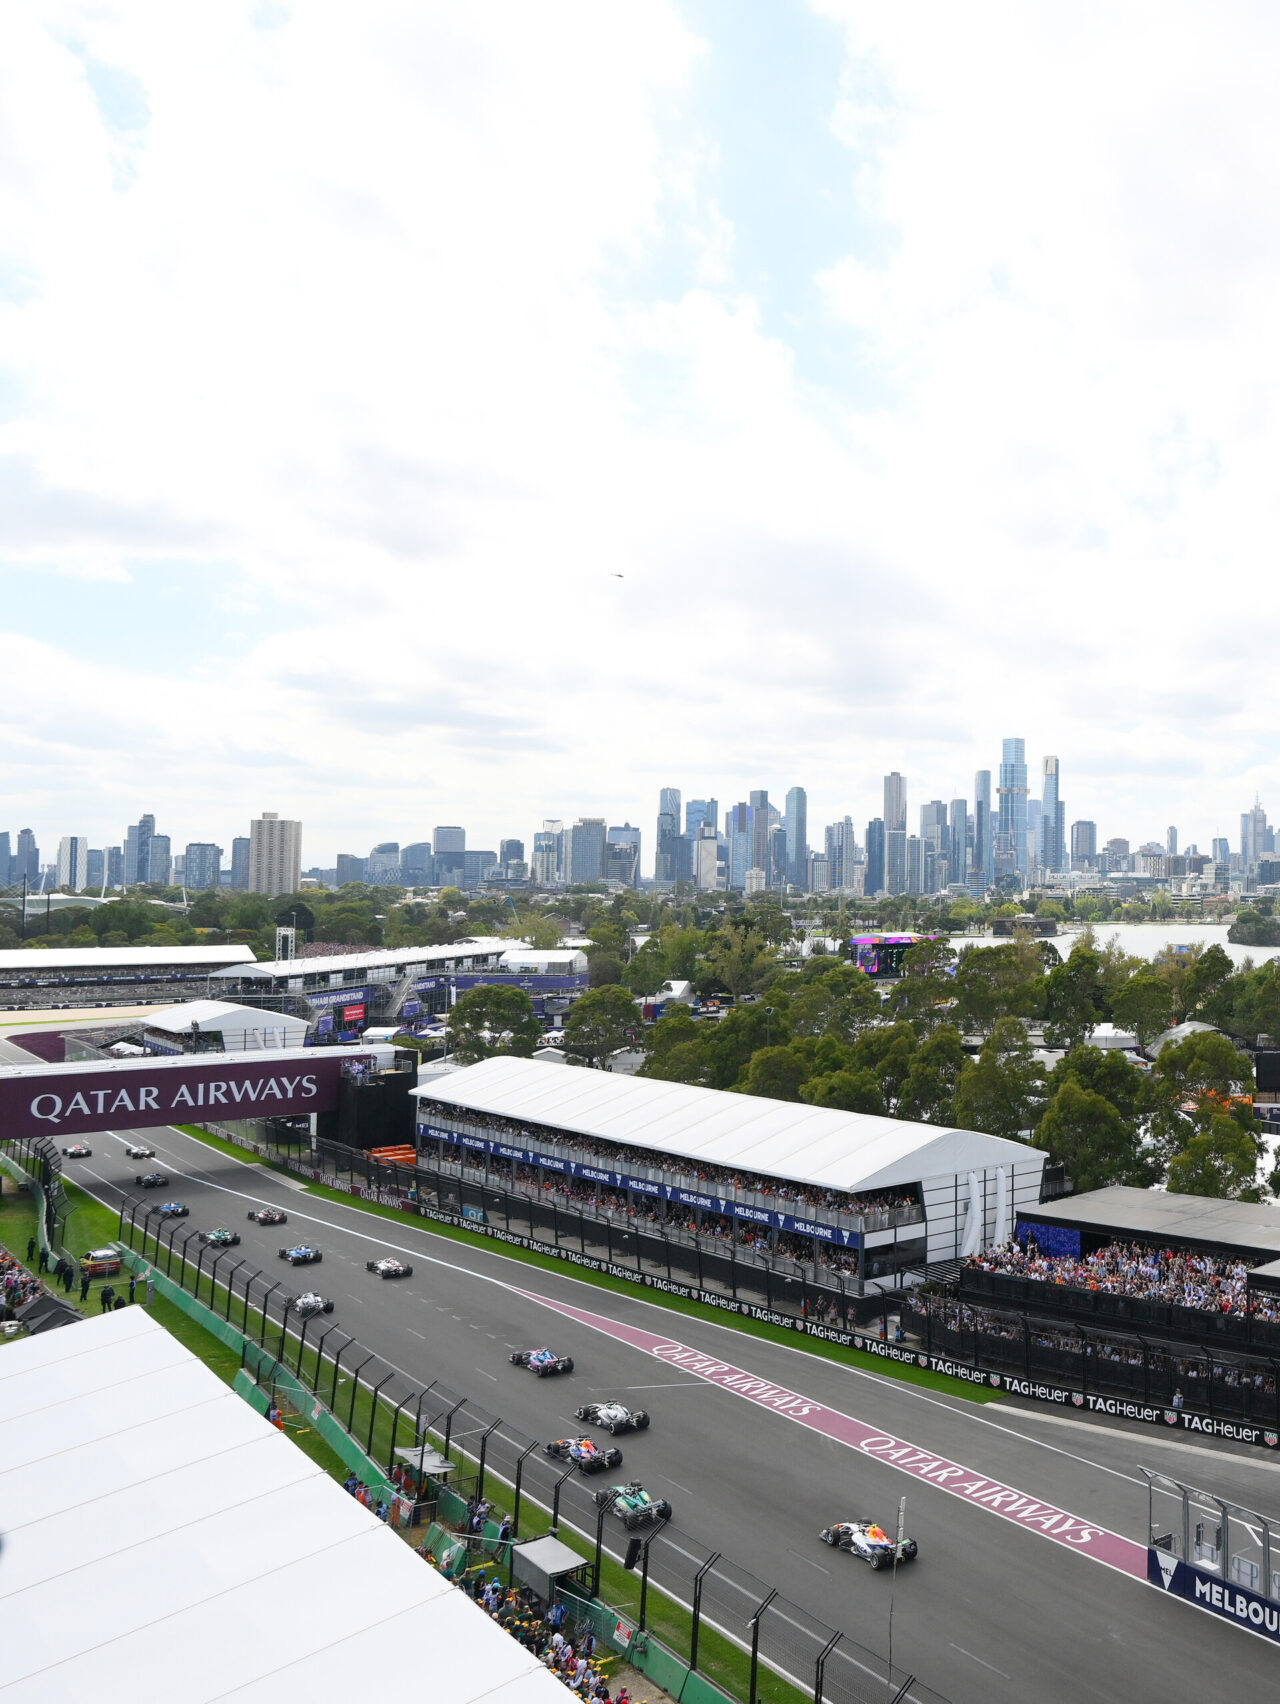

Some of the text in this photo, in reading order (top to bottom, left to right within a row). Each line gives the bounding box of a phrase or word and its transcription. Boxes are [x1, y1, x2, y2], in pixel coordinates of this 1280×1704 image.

[30, 1074, 318, 1123] QATAR AIRWAYS
[428, 1129, 448, 1140] MELBOURNE
[462, 1137, 485, 1149] MELBOURNE
[500, 1147, 523, 1159] MELBOURNE
[540, 1157, 564, 1170] MELBOURNE
[582, 1168, 610, 1182] MELBOURNE
[628, 1180, 659, 1194] MELBOURNE
[680, 1192, 712, 1208] MELBOURNE
[734, 1206, 769, 1222] MELBOURNE
[794, 1220, 832, 1239] MELBOURNE
[652, 1344, 822, 1416] QATAR AIRWAYS
[859, 1436, 1105, 1544] QATAR AIRWAYS
[1160, 1566, 1174, 1578] MEL
